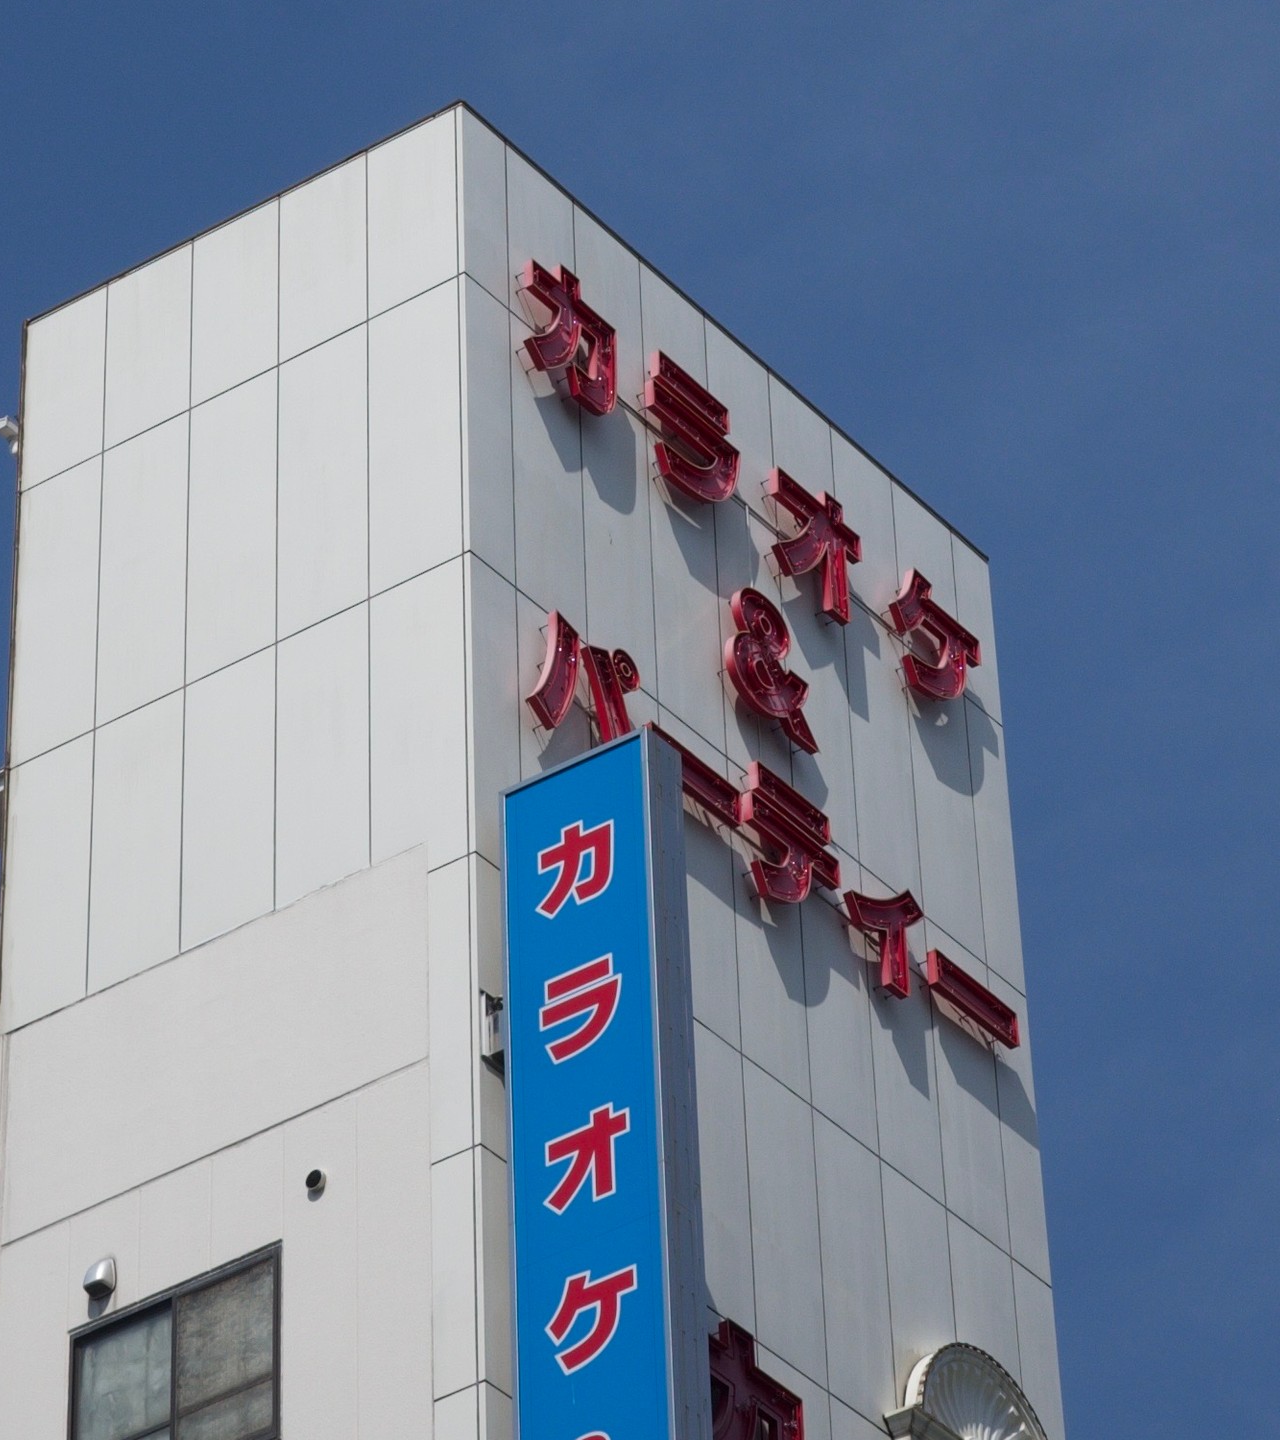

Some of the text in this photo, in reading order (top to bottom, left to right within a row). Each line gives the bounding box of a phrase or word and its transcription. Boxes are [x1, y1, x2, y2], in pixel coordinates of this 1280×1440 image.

[523, 257, 982, 703] カラオケ
[723, 586, 819, 755] &
[526, 609, 1020, 1050] パーティー
